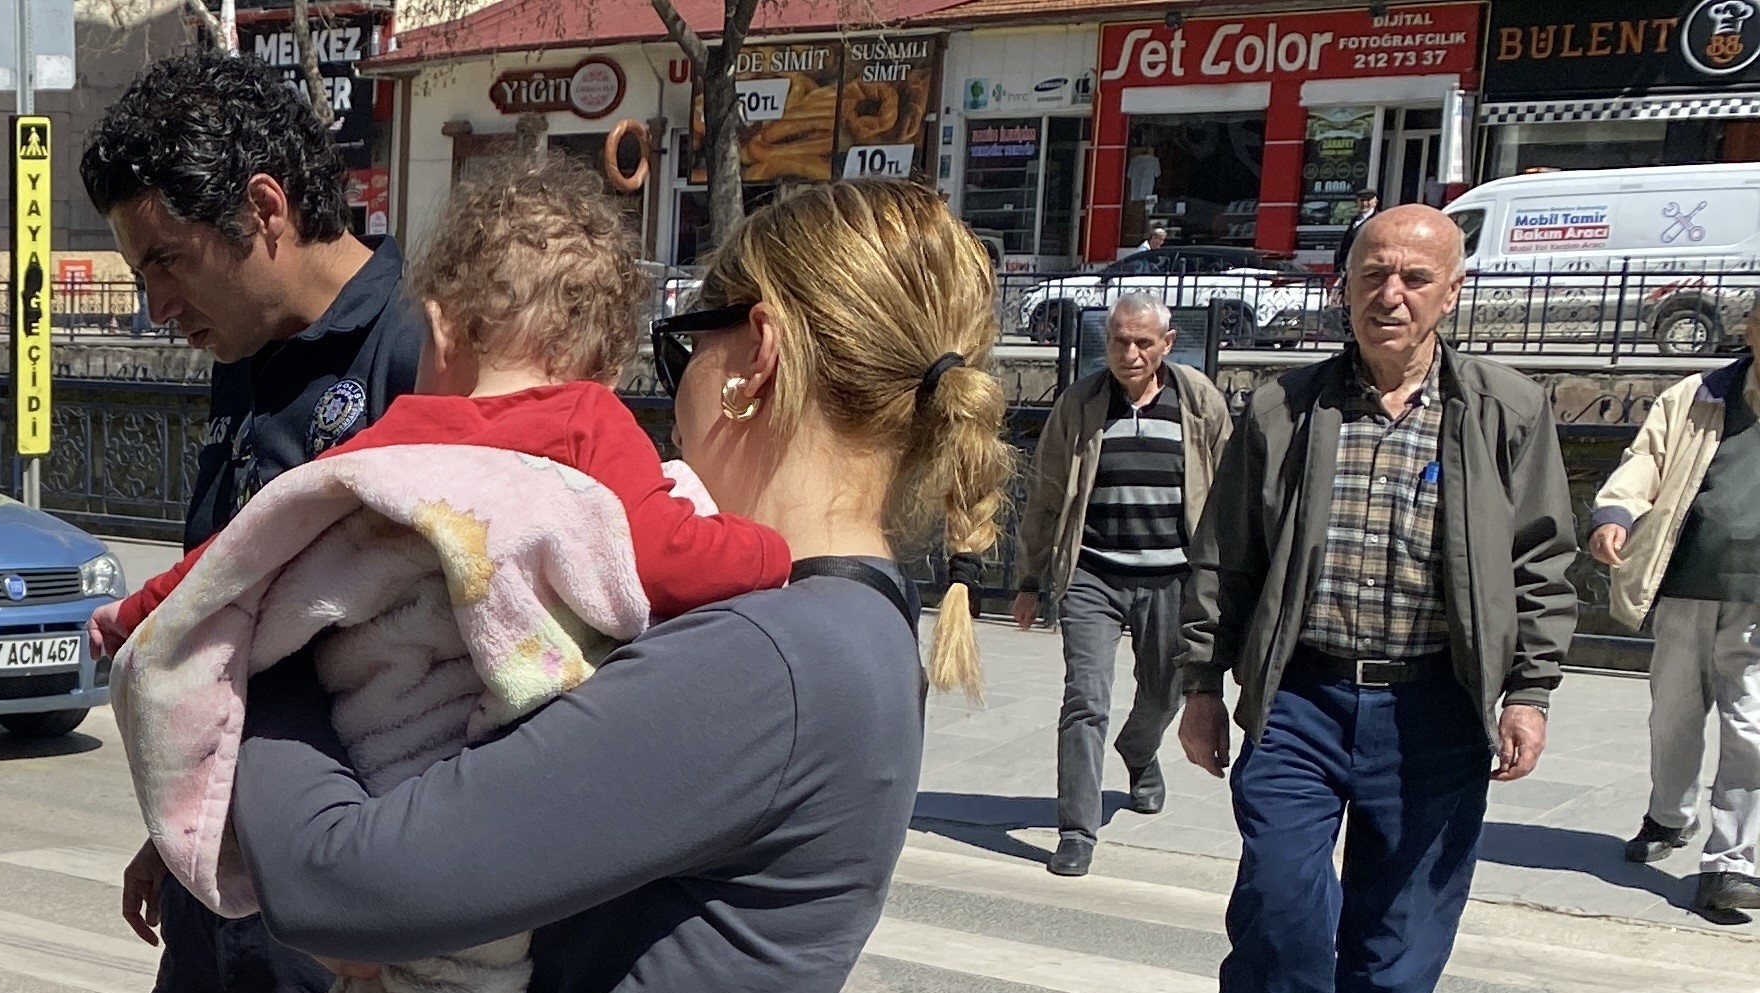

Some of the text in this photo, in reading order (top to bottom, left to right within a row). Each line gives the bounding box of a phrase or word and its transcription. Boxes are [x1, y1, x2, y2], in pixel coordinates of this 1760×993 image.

[1373, 12, 1434, 28] DİJİTAL
[736, 46, 830, 73] DE SİMİT
[851, 40, 928, 61] SUSAMLI
[1101, 22, 1334, 80] Set Color
[1354, 50, 1447, 69] 212 73 37
[862, 62, 911, 82] SİMİT
[857, 150, 903, 176] 10TL
[27, 173, 42, 267] YAYA
[1515, 212, 1607, 226] Mobil Tamir
[1512, 226, 1608, 240] Bakım Aracı
[7, 641, 44, 665] ACM
[47, 639, 78, 662] 467
